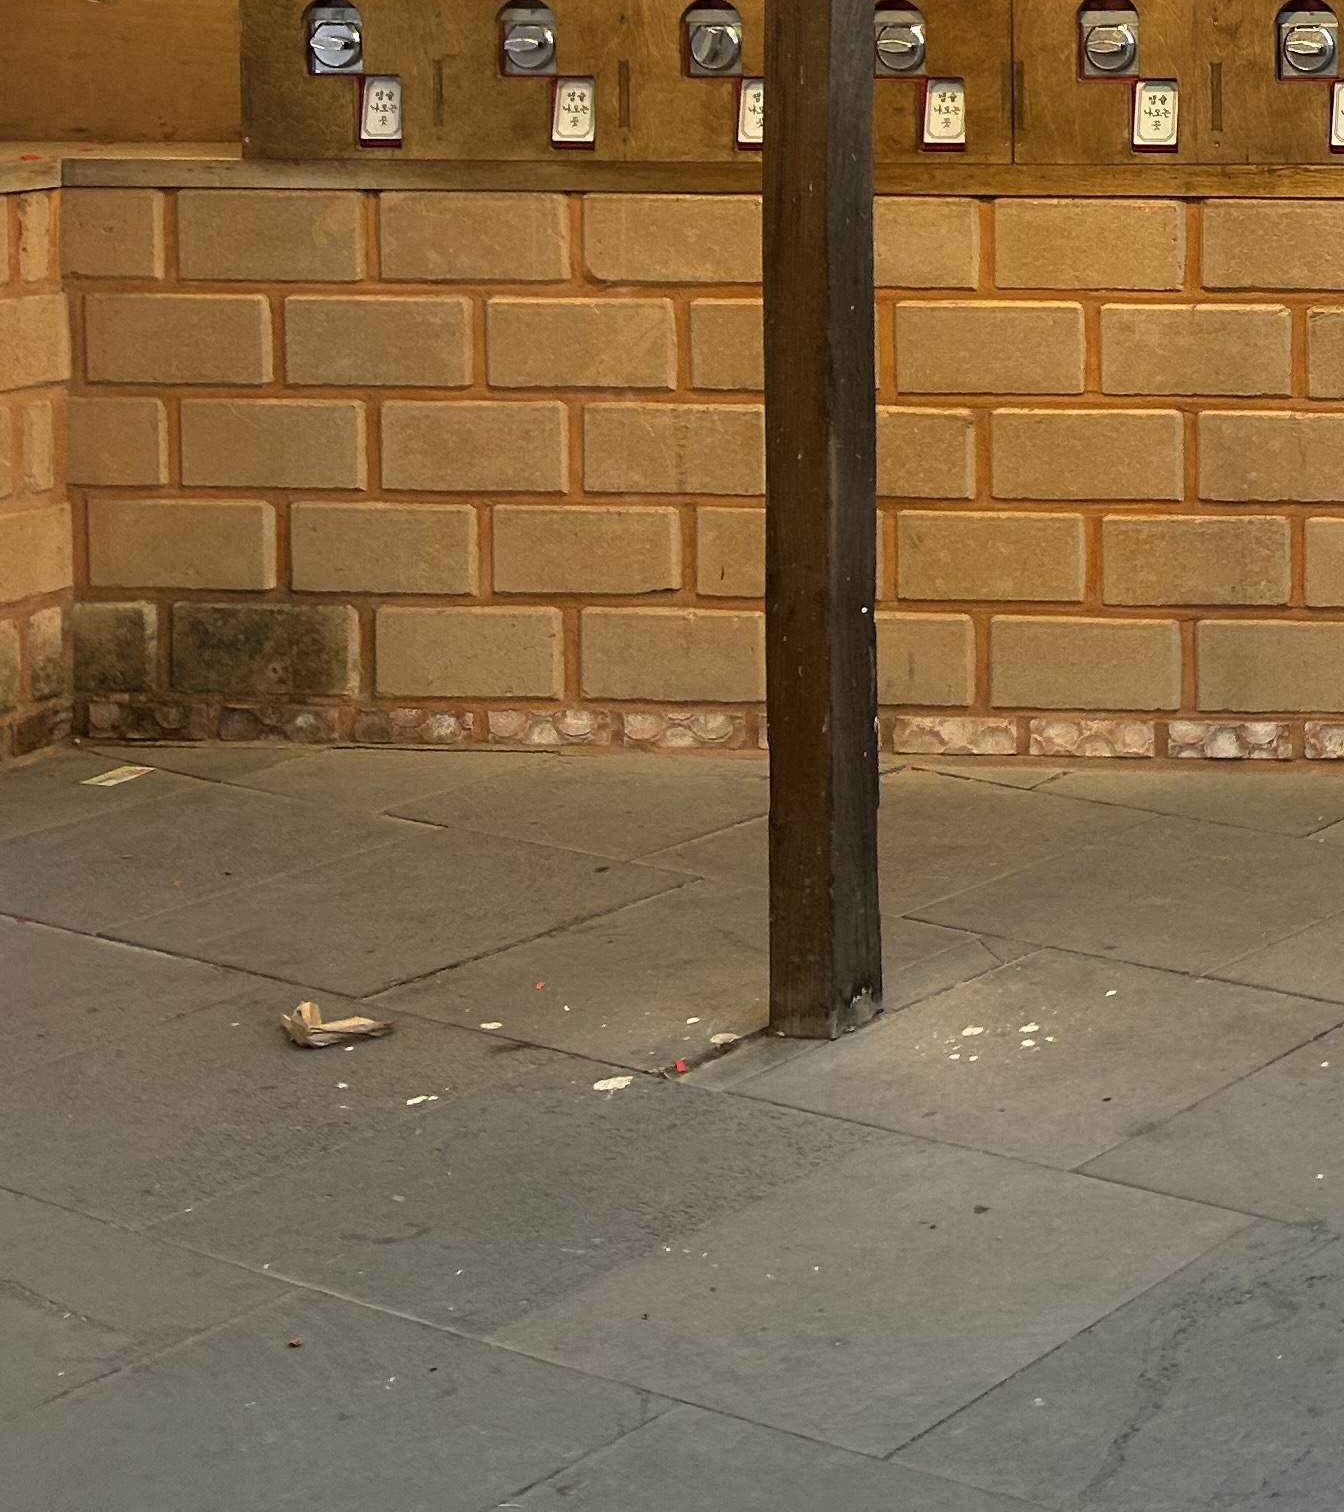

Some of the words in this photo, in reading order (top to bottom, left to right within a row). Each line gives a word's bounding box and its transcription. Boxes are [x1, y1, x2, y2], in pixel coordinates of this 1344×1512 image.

[375, 90, 395, 101] 캡슐
[567, 91, 586, 102] 캡슐
[753, 92, 763, 103] 캡
[939, 92, 957, 103] 캡슐
[1148, 95, 1168, 106] 캡슐
[370, 103, 398, 114] 나오는
[562, 103, 590, 115] 나오는
[748, 104, 763, 115] 나오
[933, 104, 961, 115] 나오는
[1143, 107, 1171, 119] 나오는
[378, 116, 388, 126] 곳
[569, 117, 579, 127] 곳
[942, 117, 951, 128] 곳
[1151, 120, 1161, 131] 곳
